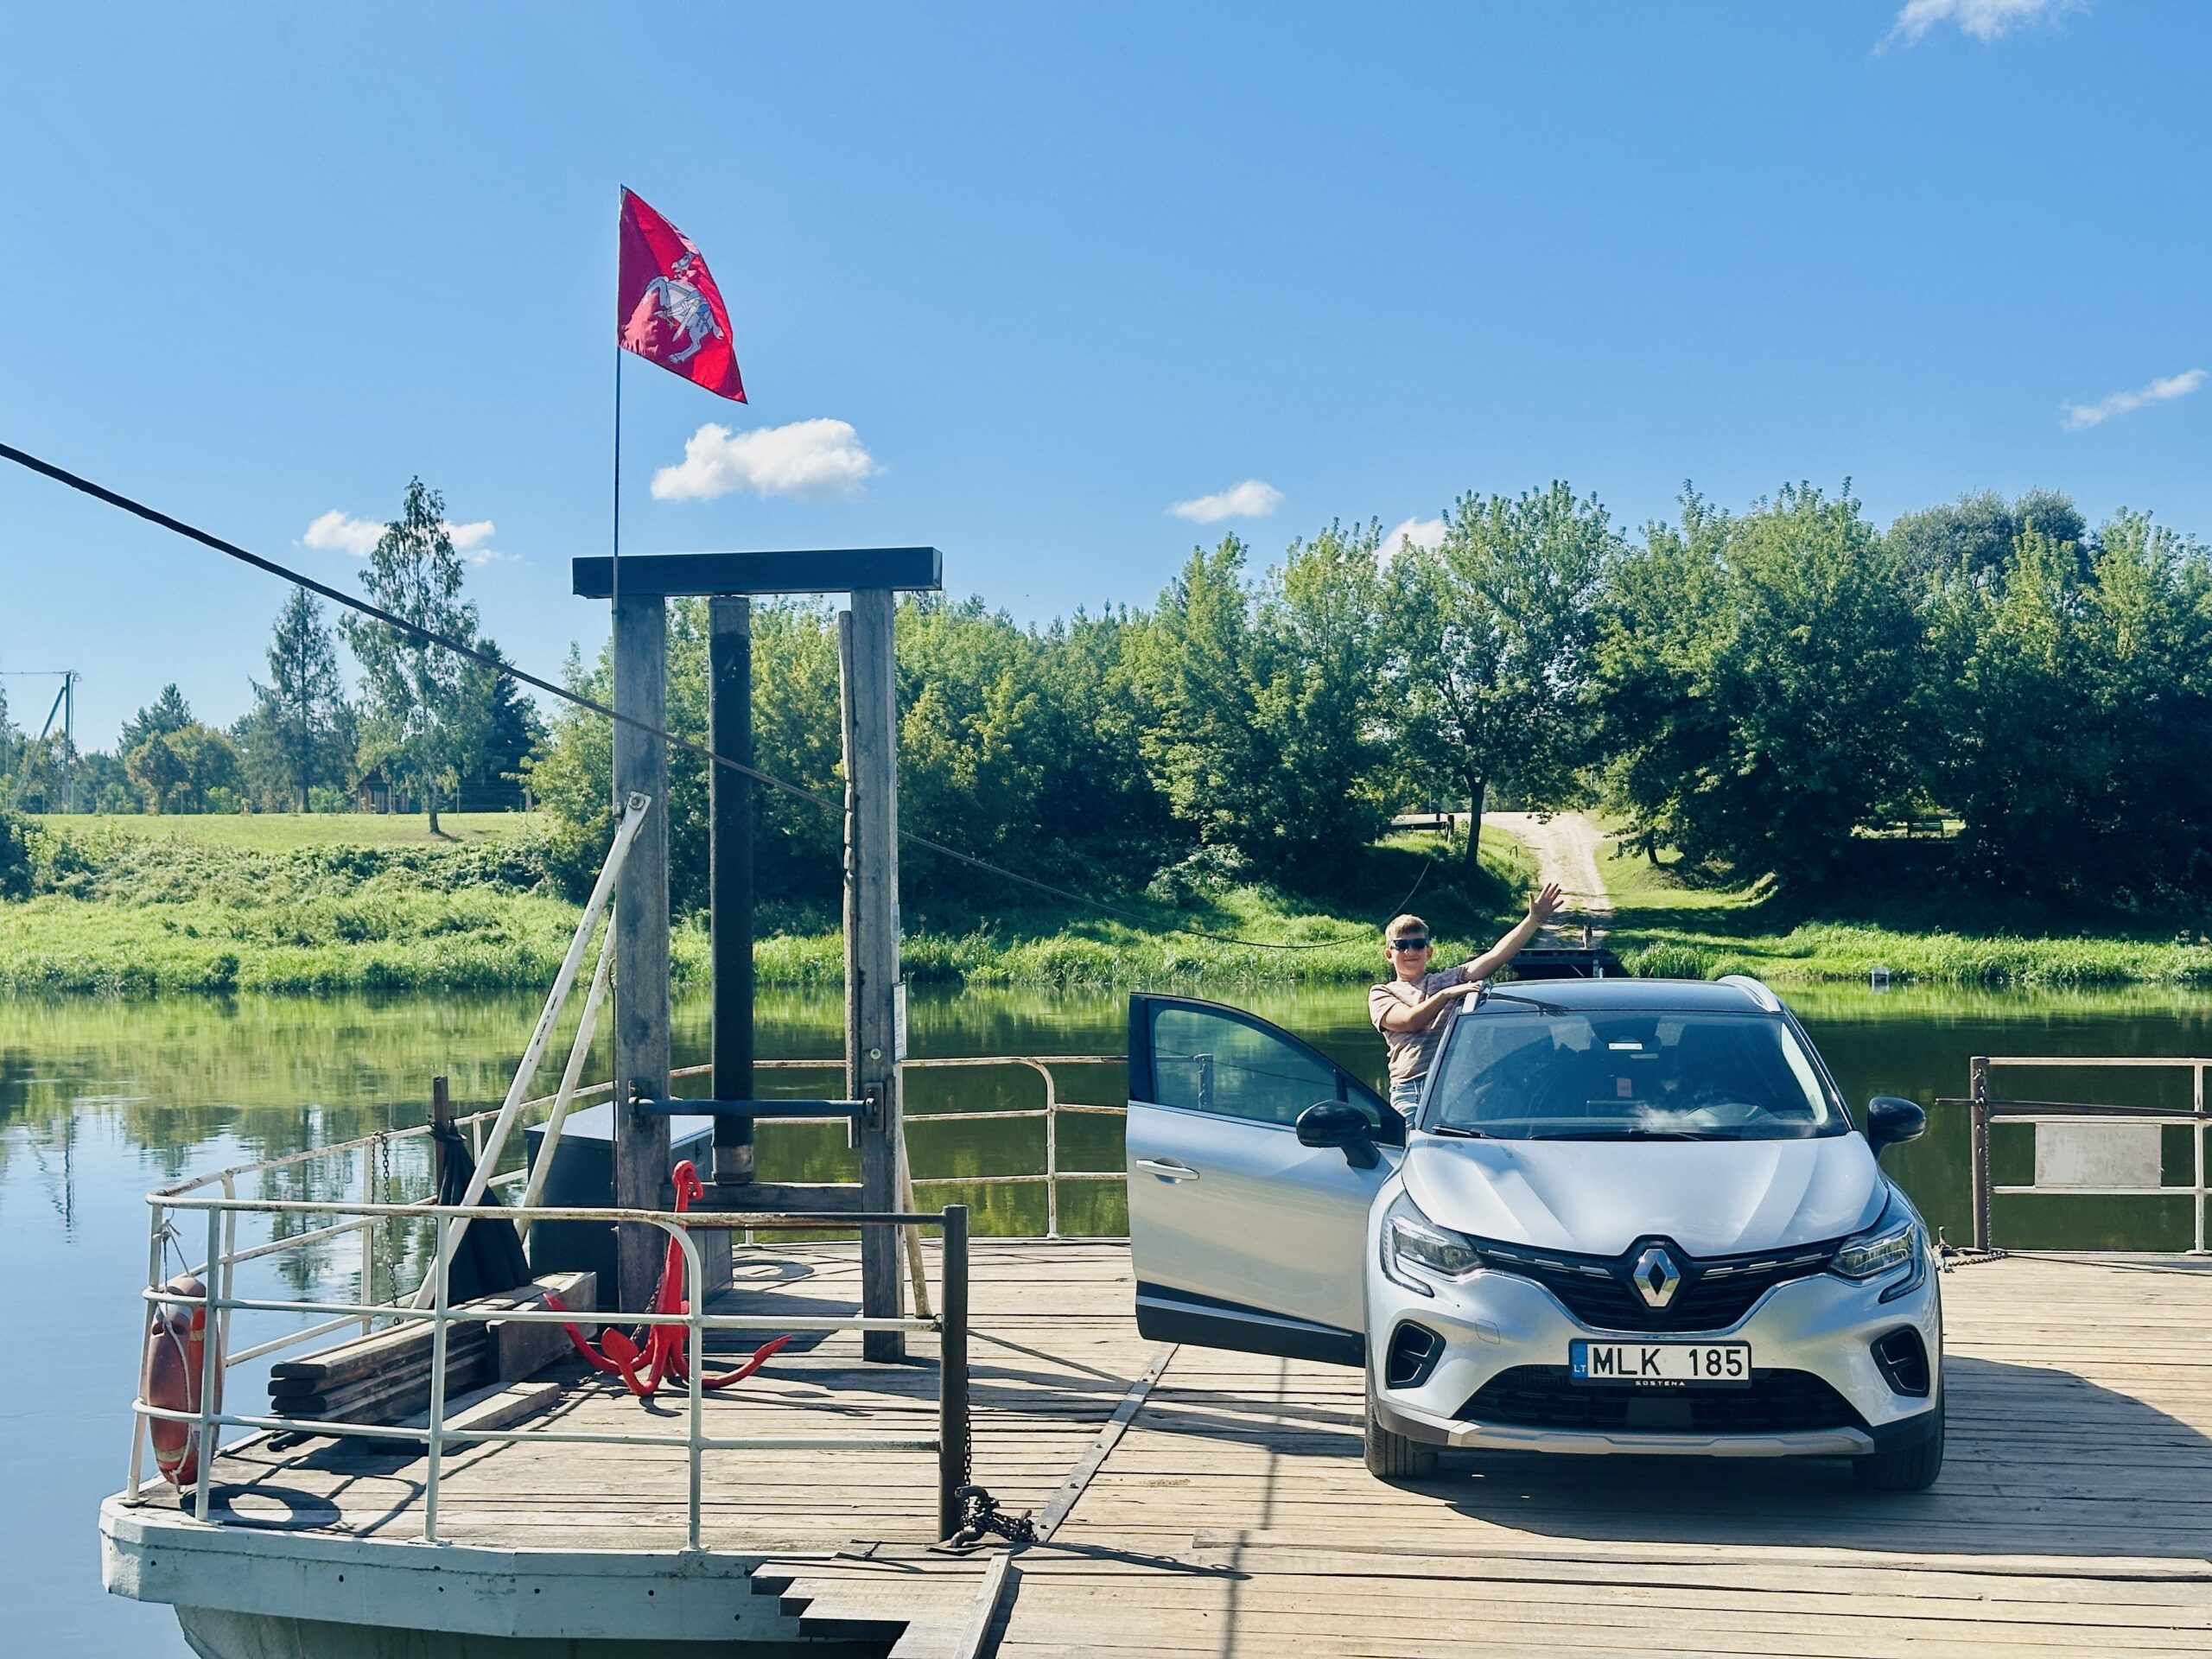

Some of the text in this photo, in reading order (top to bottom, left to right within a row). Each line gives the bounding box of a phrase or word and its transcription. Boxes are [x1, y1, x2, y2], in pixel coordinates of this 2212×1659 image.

[1573, 1364, 1586, 1373] LT
[1593, 1347, 1742, 1376] MLK 185
